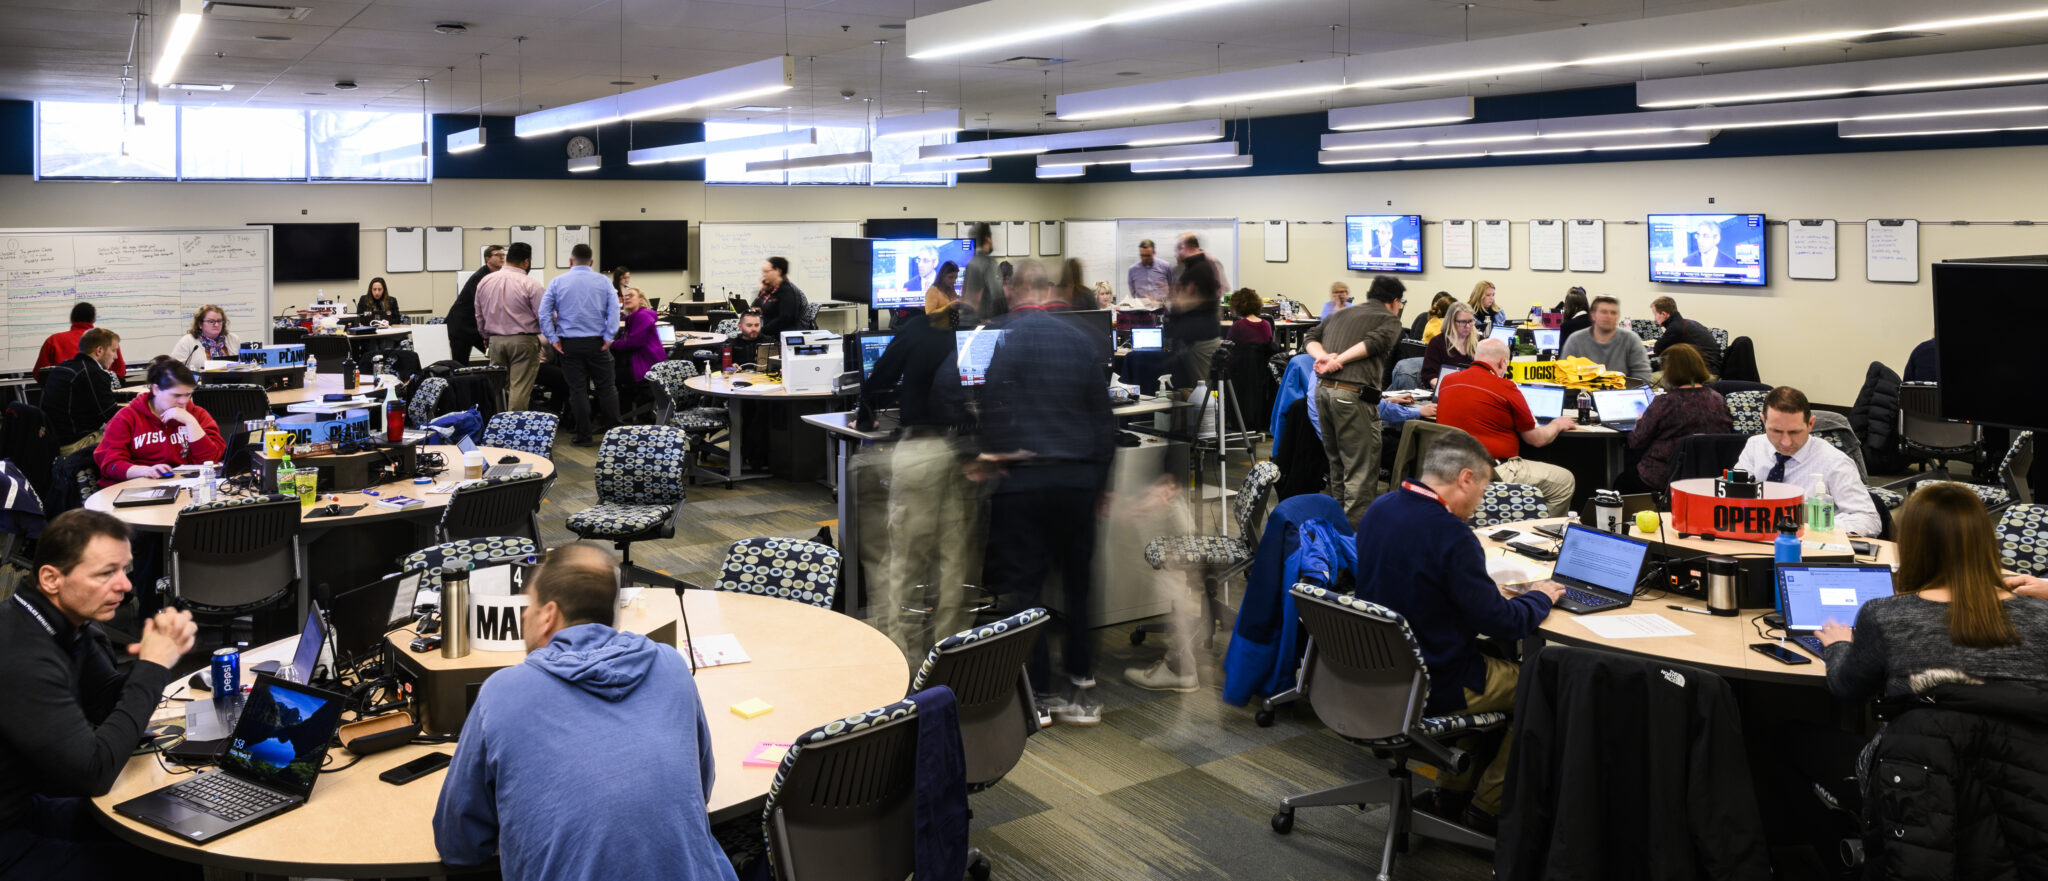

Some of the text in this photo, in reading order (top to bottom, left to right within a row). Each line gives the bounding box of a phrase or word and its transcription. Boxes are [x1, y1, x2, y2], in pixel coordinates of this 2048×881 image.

[1718, 482, 1726, 498] 5
[1756, 484, 1763, 499] 5
[513, 566, 523, 588] 4
[223, 664, 233, 692] pepsi
